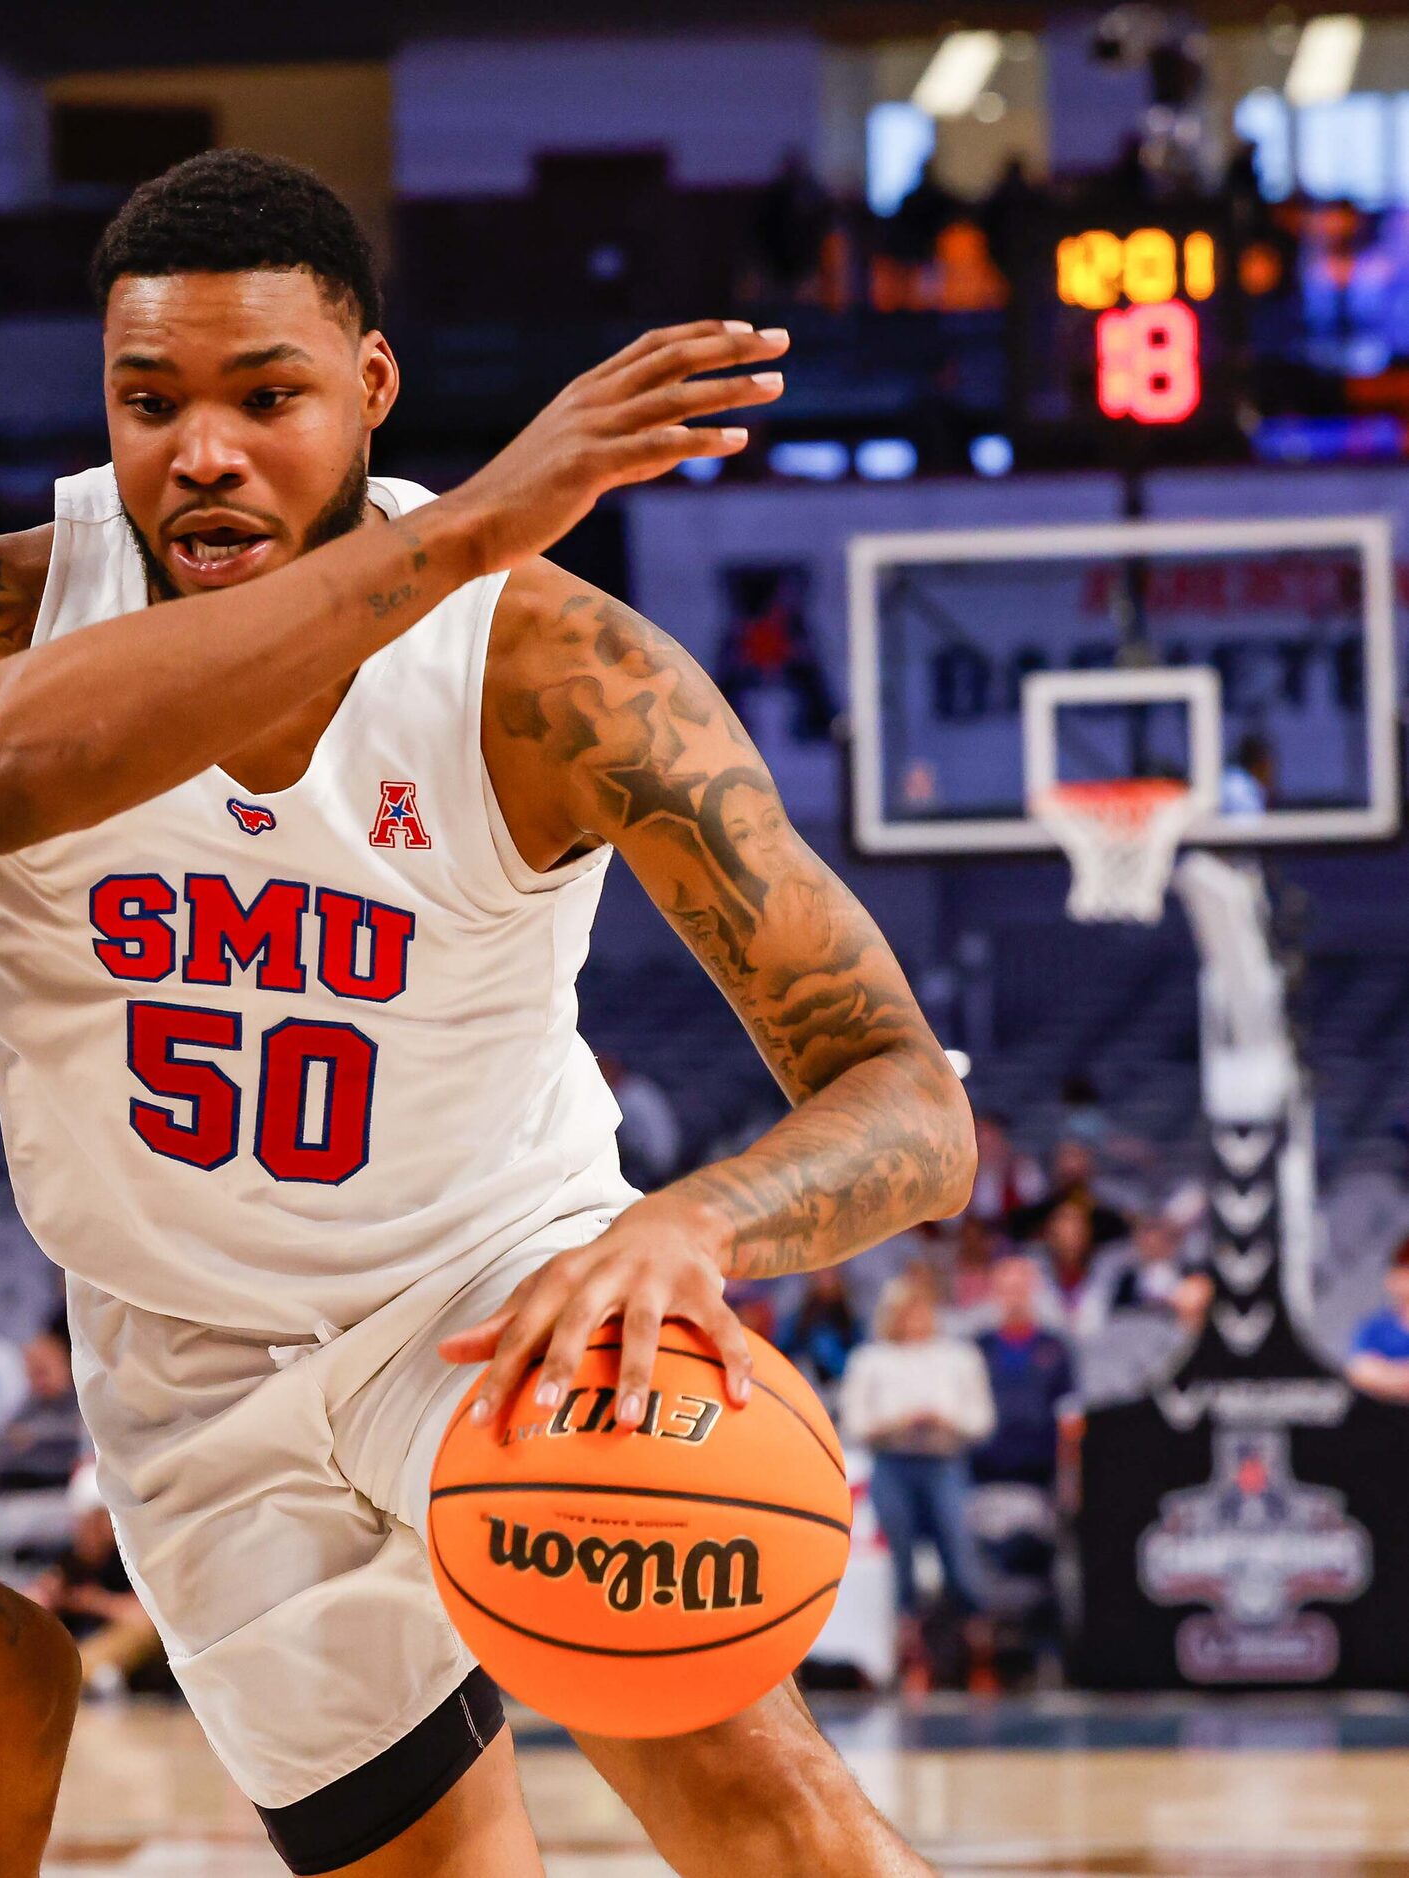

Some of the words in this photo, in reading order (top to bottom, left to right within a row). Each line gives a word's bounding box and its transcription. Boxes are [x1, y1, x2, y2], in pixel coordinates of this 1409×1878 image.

[369, 781, 432, 850] A
[89, 873, 416, 1003] SMU
[126, 1000, 378, 1186] 50
[489, 1515, 764, 1613] Wilson
